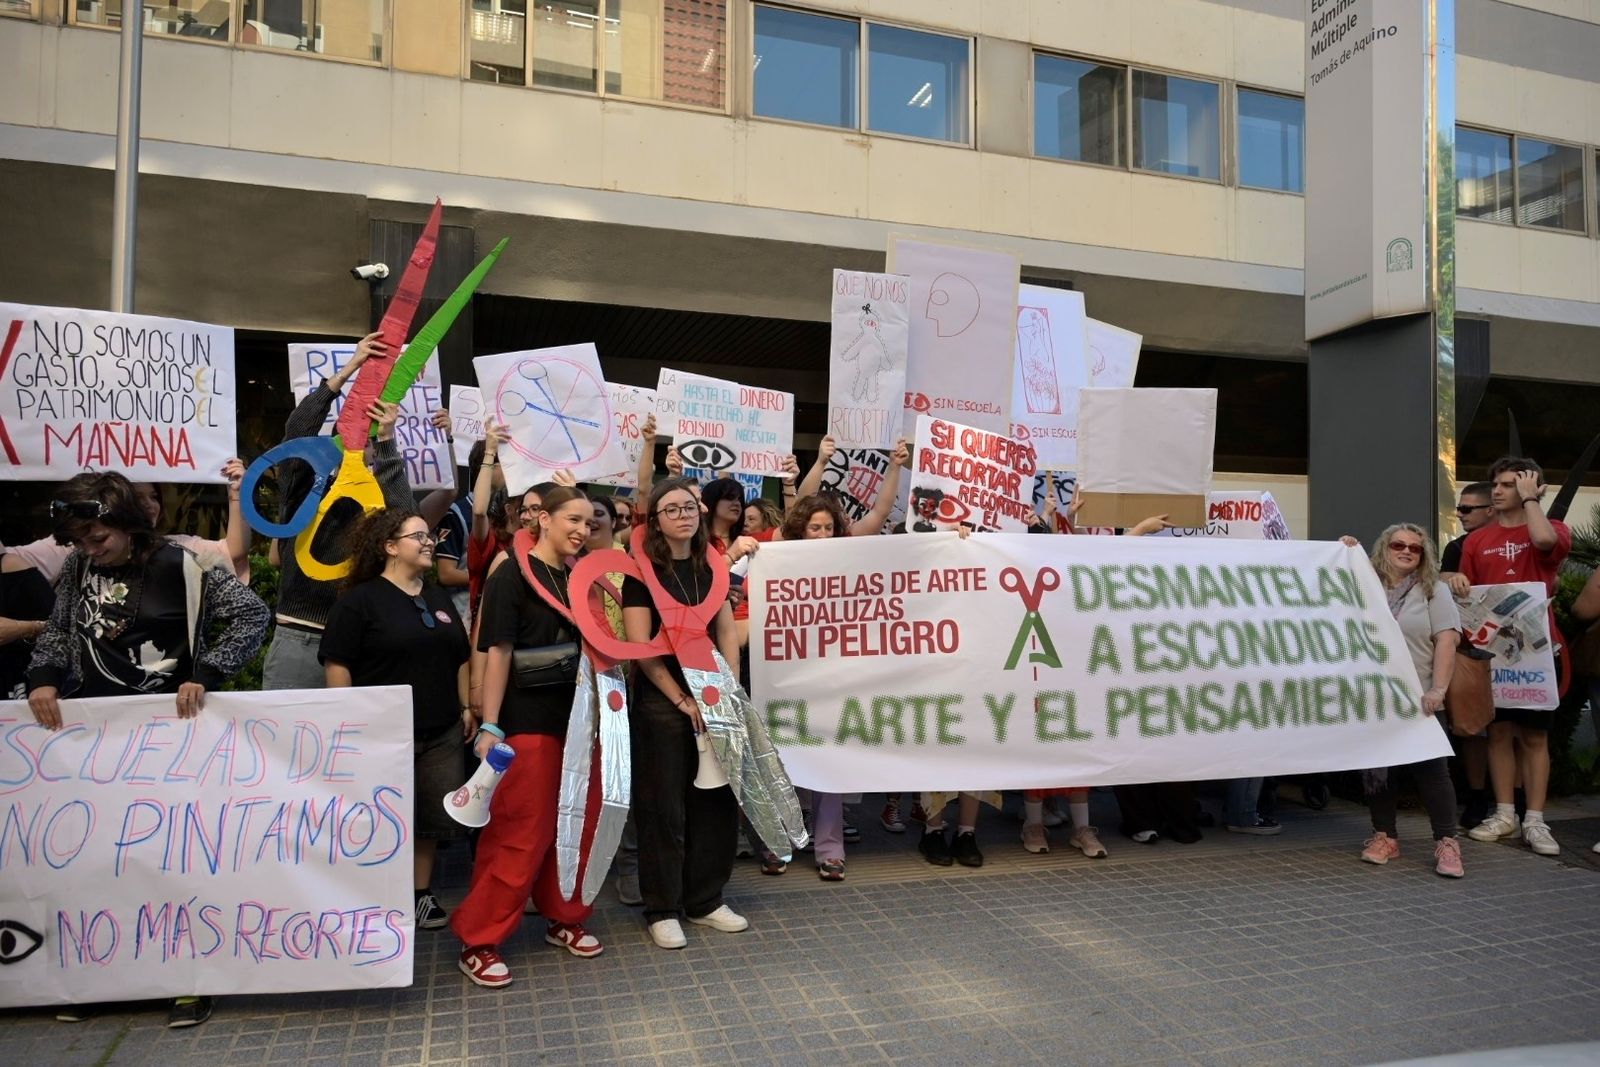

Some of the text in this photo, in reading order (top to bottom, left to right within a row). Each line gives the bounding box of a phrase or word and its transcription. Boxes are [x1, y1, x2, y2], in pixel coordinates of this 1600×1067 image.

[1310, 25, 1398, 87] Tomás de Aquino
[1311, 14, 1358, 60] Múltiple
[835, 273, 908, 304] QUE NO NOS
[33, 320, 211, 367] NO SOMOS UN
[12, 352, 105, 390] GASTO,
[116, 358, 194, 393] SOMOS
[662, 370, 676, 385] LA
[16, 388, 175, 424] PATRIMONIO
[612, 391, 636, 405] MOS
[678, 401, 700, 420] QUE
[748, 409, 761, 427] AL
[683, 384, 785, 412] HASTA EL DINERO
[933, 399, 1002, 415] SIN ESCUELA
[678, 419, 777, 445] BOLSILLO NECESITA
[830, 406, 897, 444] RECORTEN
[1031, 427, 1077, 439] SIN ESCUE
[44, 422, 196, 470] MAÑANA
[741, 450, 784, 472] DISEÑO
[930, 420, 1037, 478] SI QUIERES
[919, 447, 1022, 500] RECORTAR
[984, 510, 1003, 530] EL
[765, 567, 988, 602] ESCUELAS DE ARTE
[1069, 563, 1367, 613] DESMANTELAN
[764, 597, 904, 628] ANDALUZAS
[764, 619, 960, 661] EN PELIGRO
[1086, 624, 1122, 675] A
[1129, 617, 1390, 675] ESCONDIDAS
[765, 672, 1419, 748] EL ARTE Y EL PENSAMIENTO
[1501, 687, 1548, 703] RECORTES
[288, 721, 369, 784] DE
[0, 786, 408, 877] NO PINTAMOS
[57, 896, 406, 968] NO MÁS RECORTES
